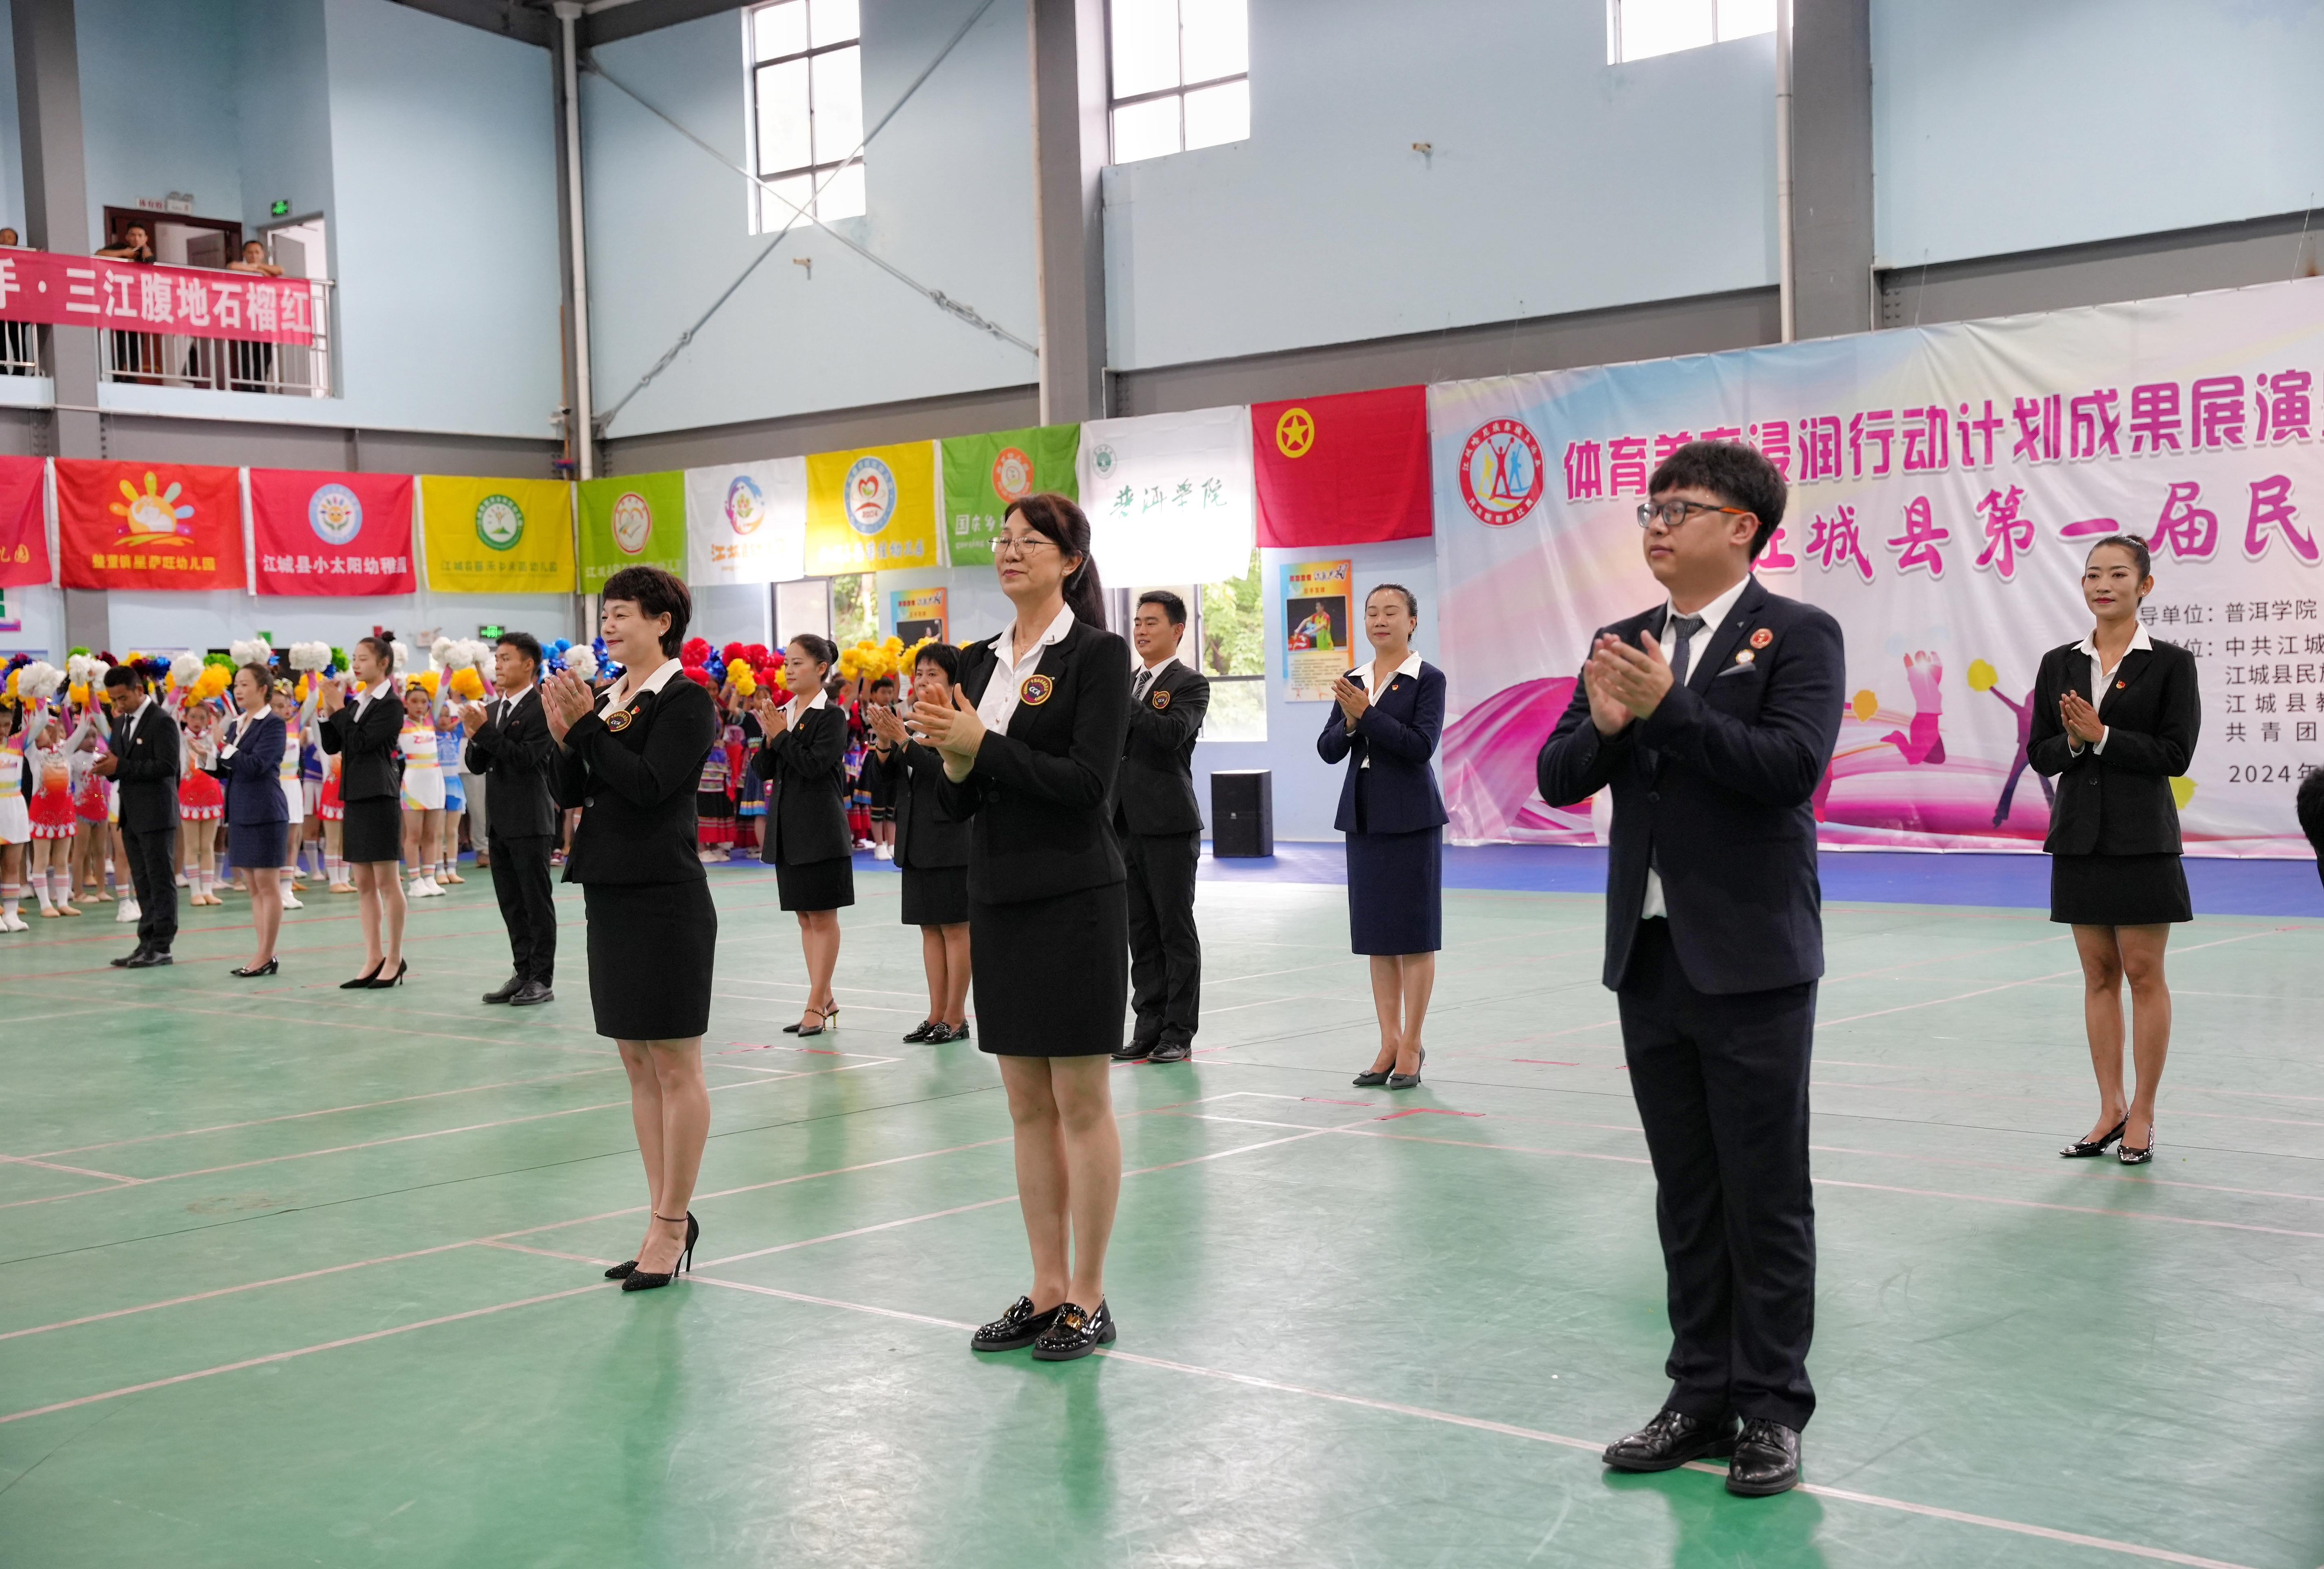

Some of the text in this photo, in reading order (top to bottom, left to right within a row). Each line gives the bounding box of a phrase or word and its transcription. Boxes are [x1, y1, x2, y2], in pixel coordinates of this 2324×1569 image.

[1564, 369, 2324, 500] 体育浸润行动计划成果展演
[955, 514, 1006, 535] 国庆乡
[2226, 664, 2324, 685] 江城县民
[1029, 686, 1041, 696] CCA
[2226, 721, 2317, 742] 共青团
